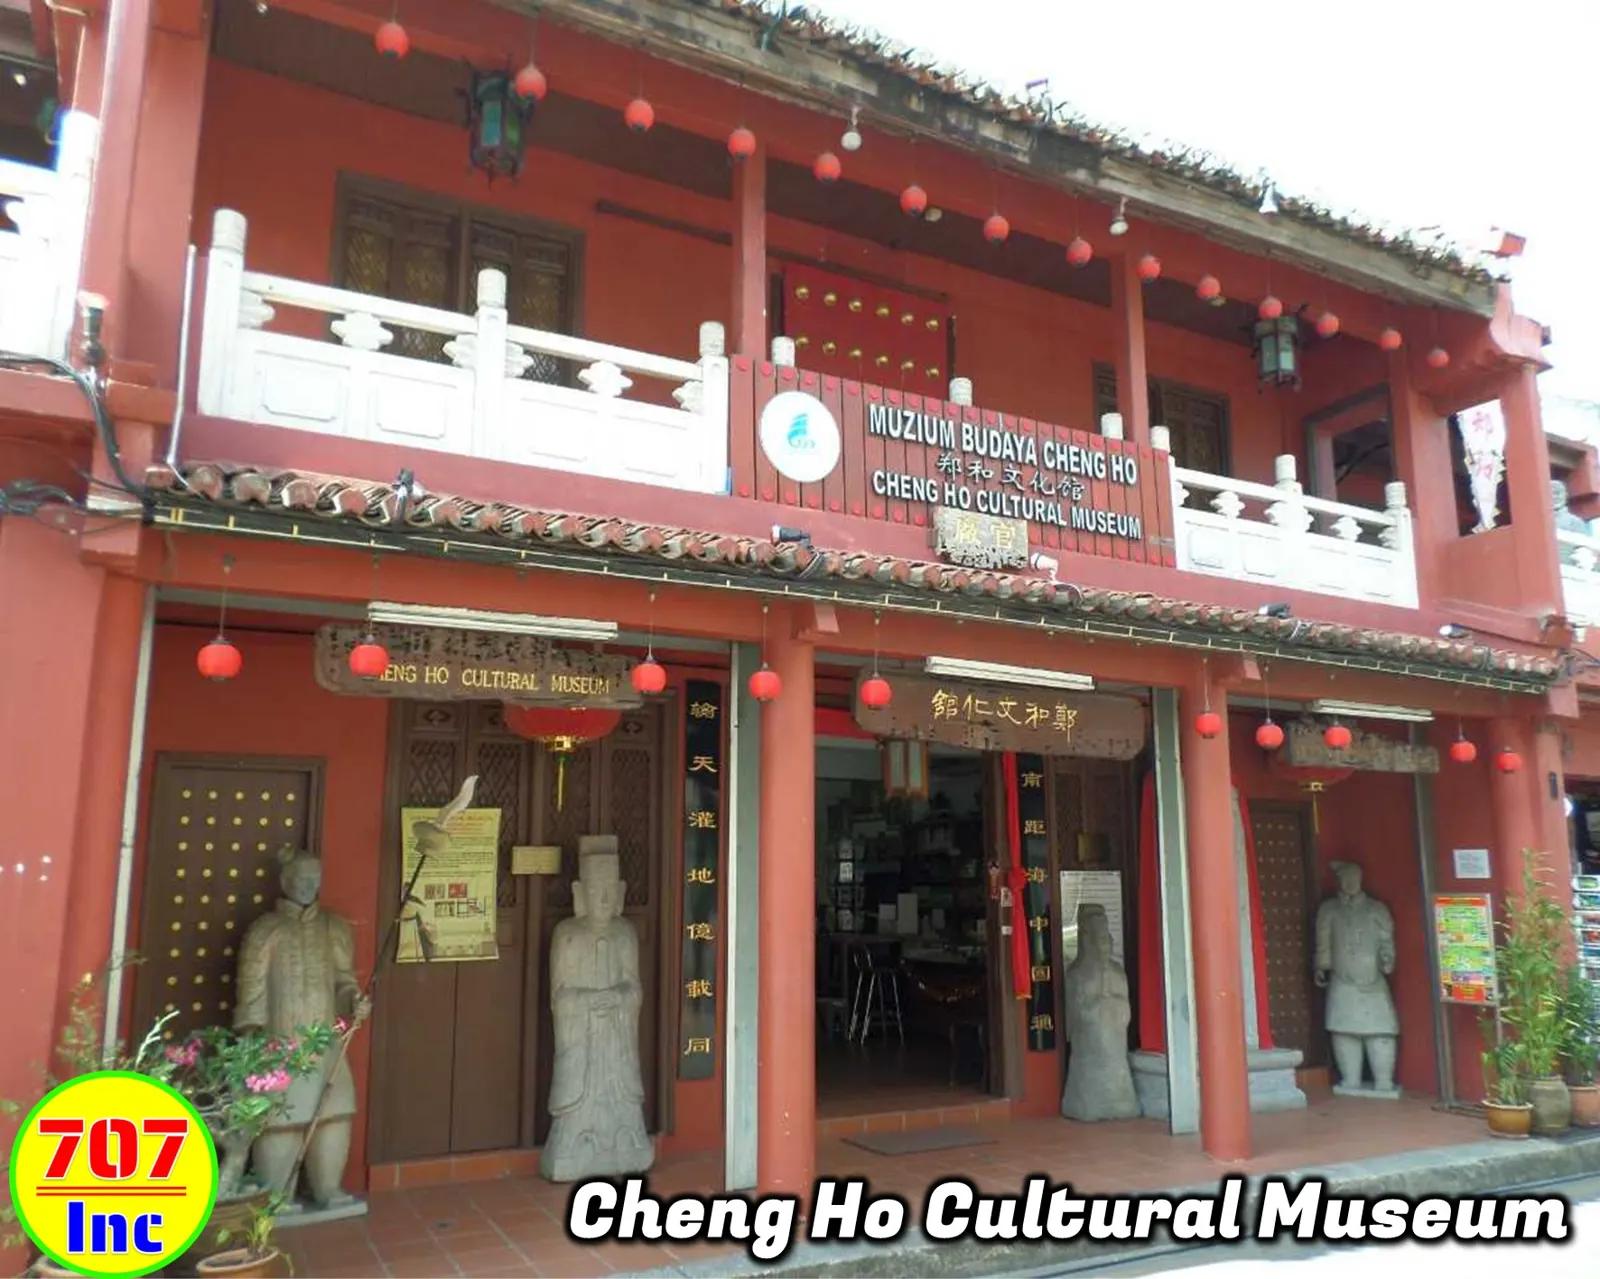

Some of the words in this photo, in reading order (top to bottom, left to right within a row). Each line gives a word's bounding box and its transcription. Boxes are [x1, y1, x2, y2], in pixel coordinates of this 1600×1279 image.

[868, 402, 956, 449] MUZIUM
[962, 423, 1038, 467] BUDAYA
[1043, 440, 1106, 480] CHENG
[1112, 454, 1138, 485] HO
[872, 470, 938, 503] CHENG
[944, 482, 972, 510] HO
[976, 489, 1067, 528] CULTURAL
[1071, 505, 1142, 540] MUSEUM
[936, 452, 1085, 500] 郑和文化馆
[424, 666, 449, 685] HO
[461, 668, 539, 691] CULTURAL
[551, 674, 610, 695] MUSEUM
